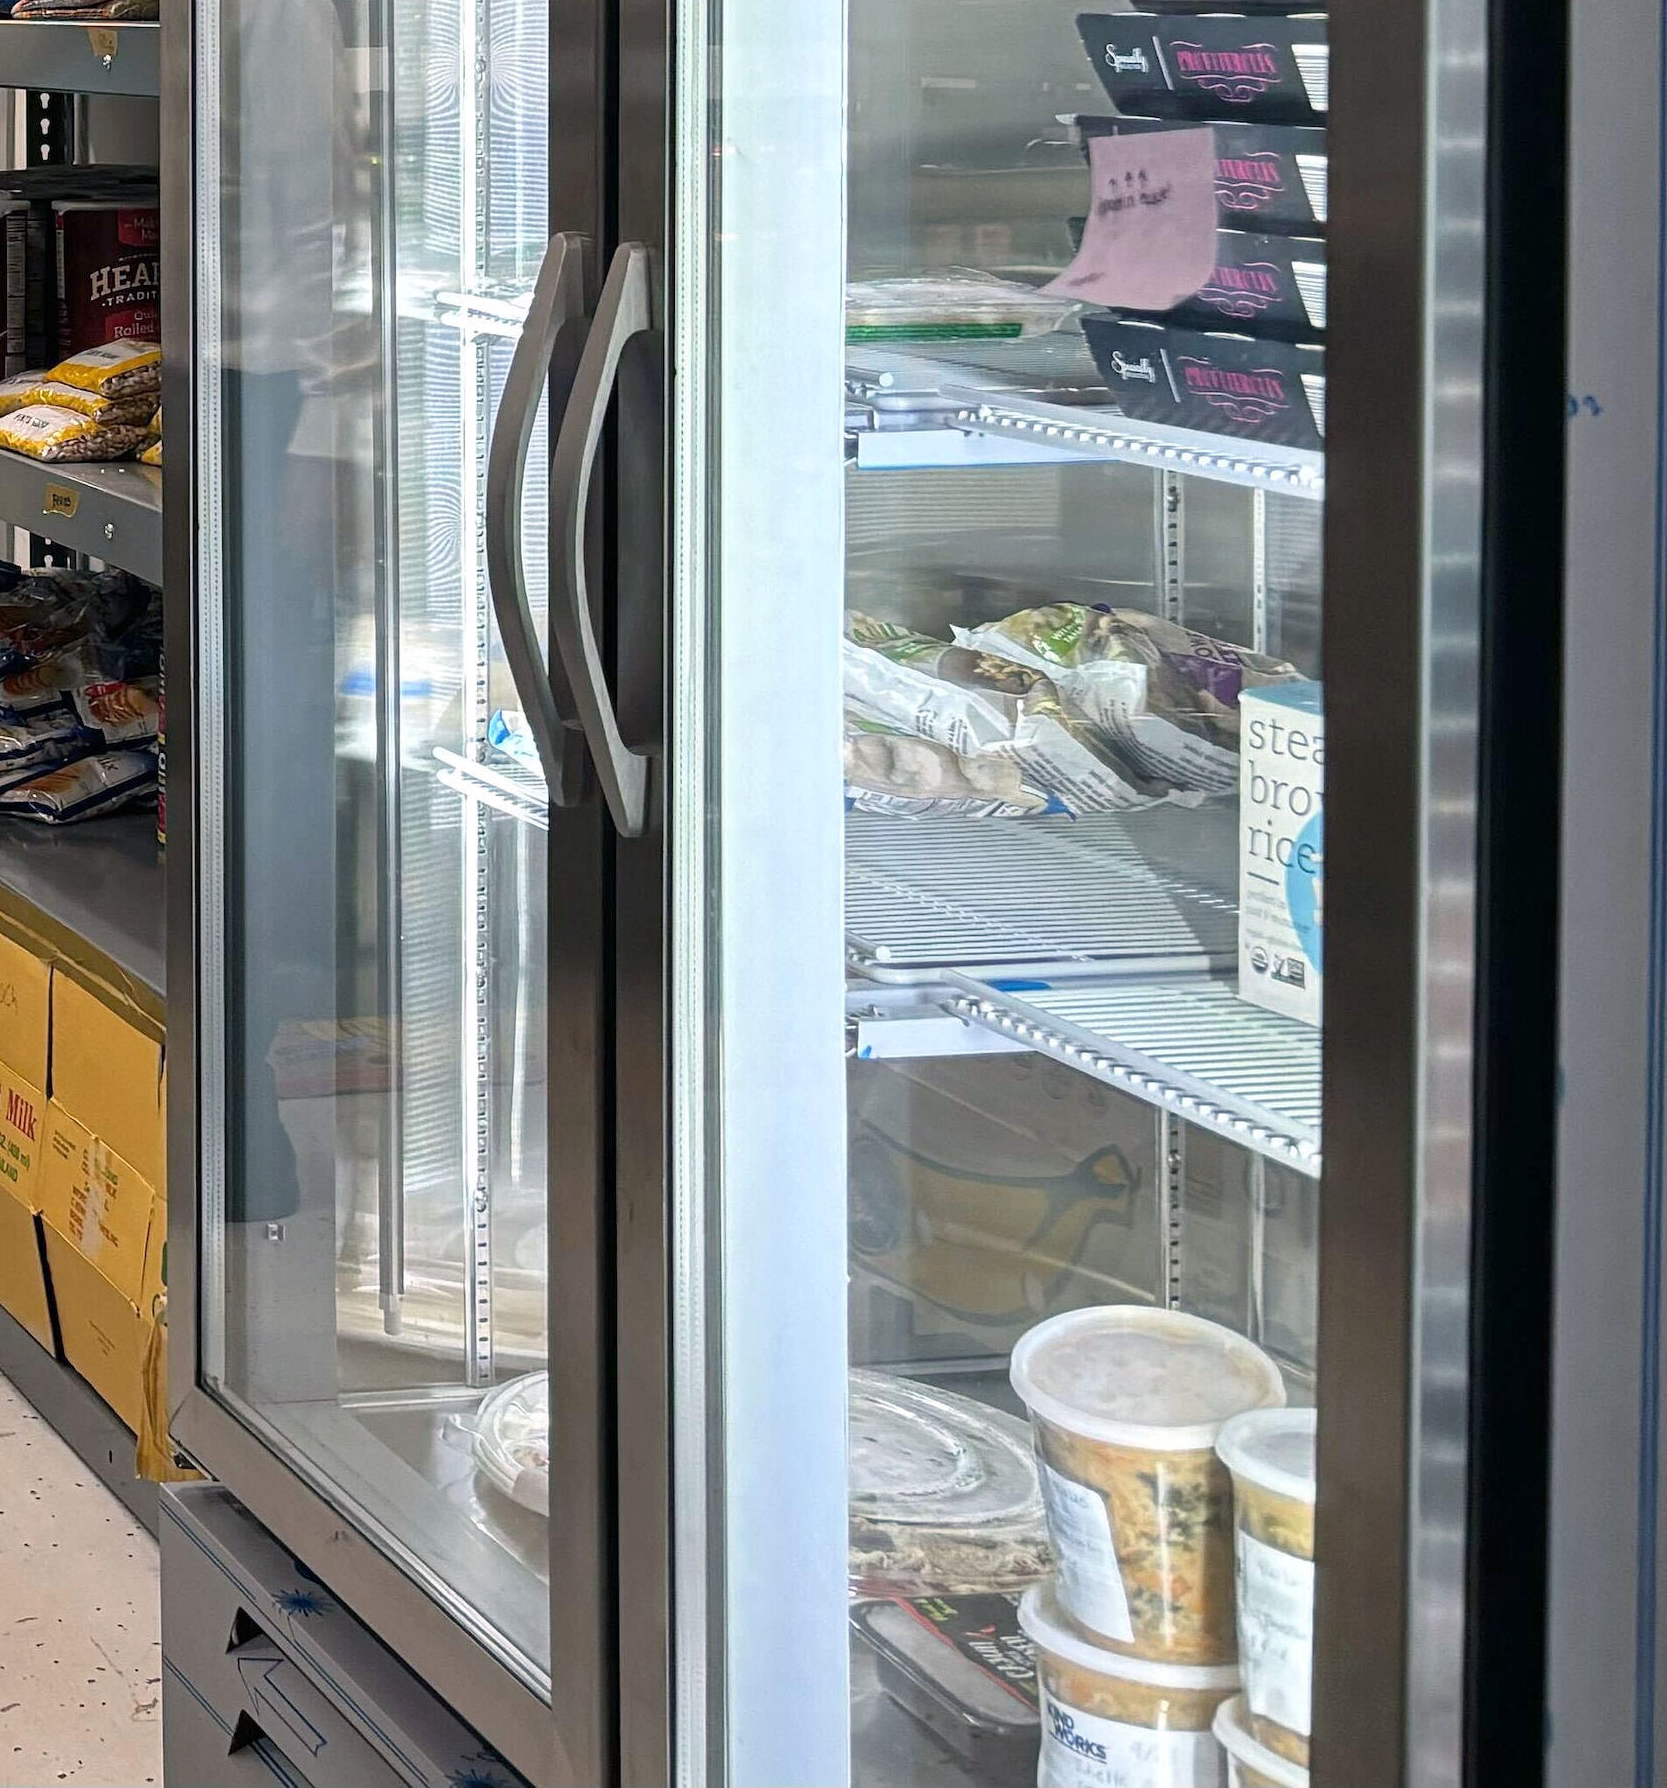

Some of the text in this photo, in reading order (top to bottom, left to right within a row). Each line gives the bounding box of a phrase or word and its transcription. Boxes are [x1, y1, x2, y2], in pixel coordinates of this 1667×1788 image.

[1248, 759, 1325, 817] bro
[1247, 819, 1317, 876] rice
[5, 1085, 38, 1142] Milk
[1054, 1722, 1107, 1760] WORKS
